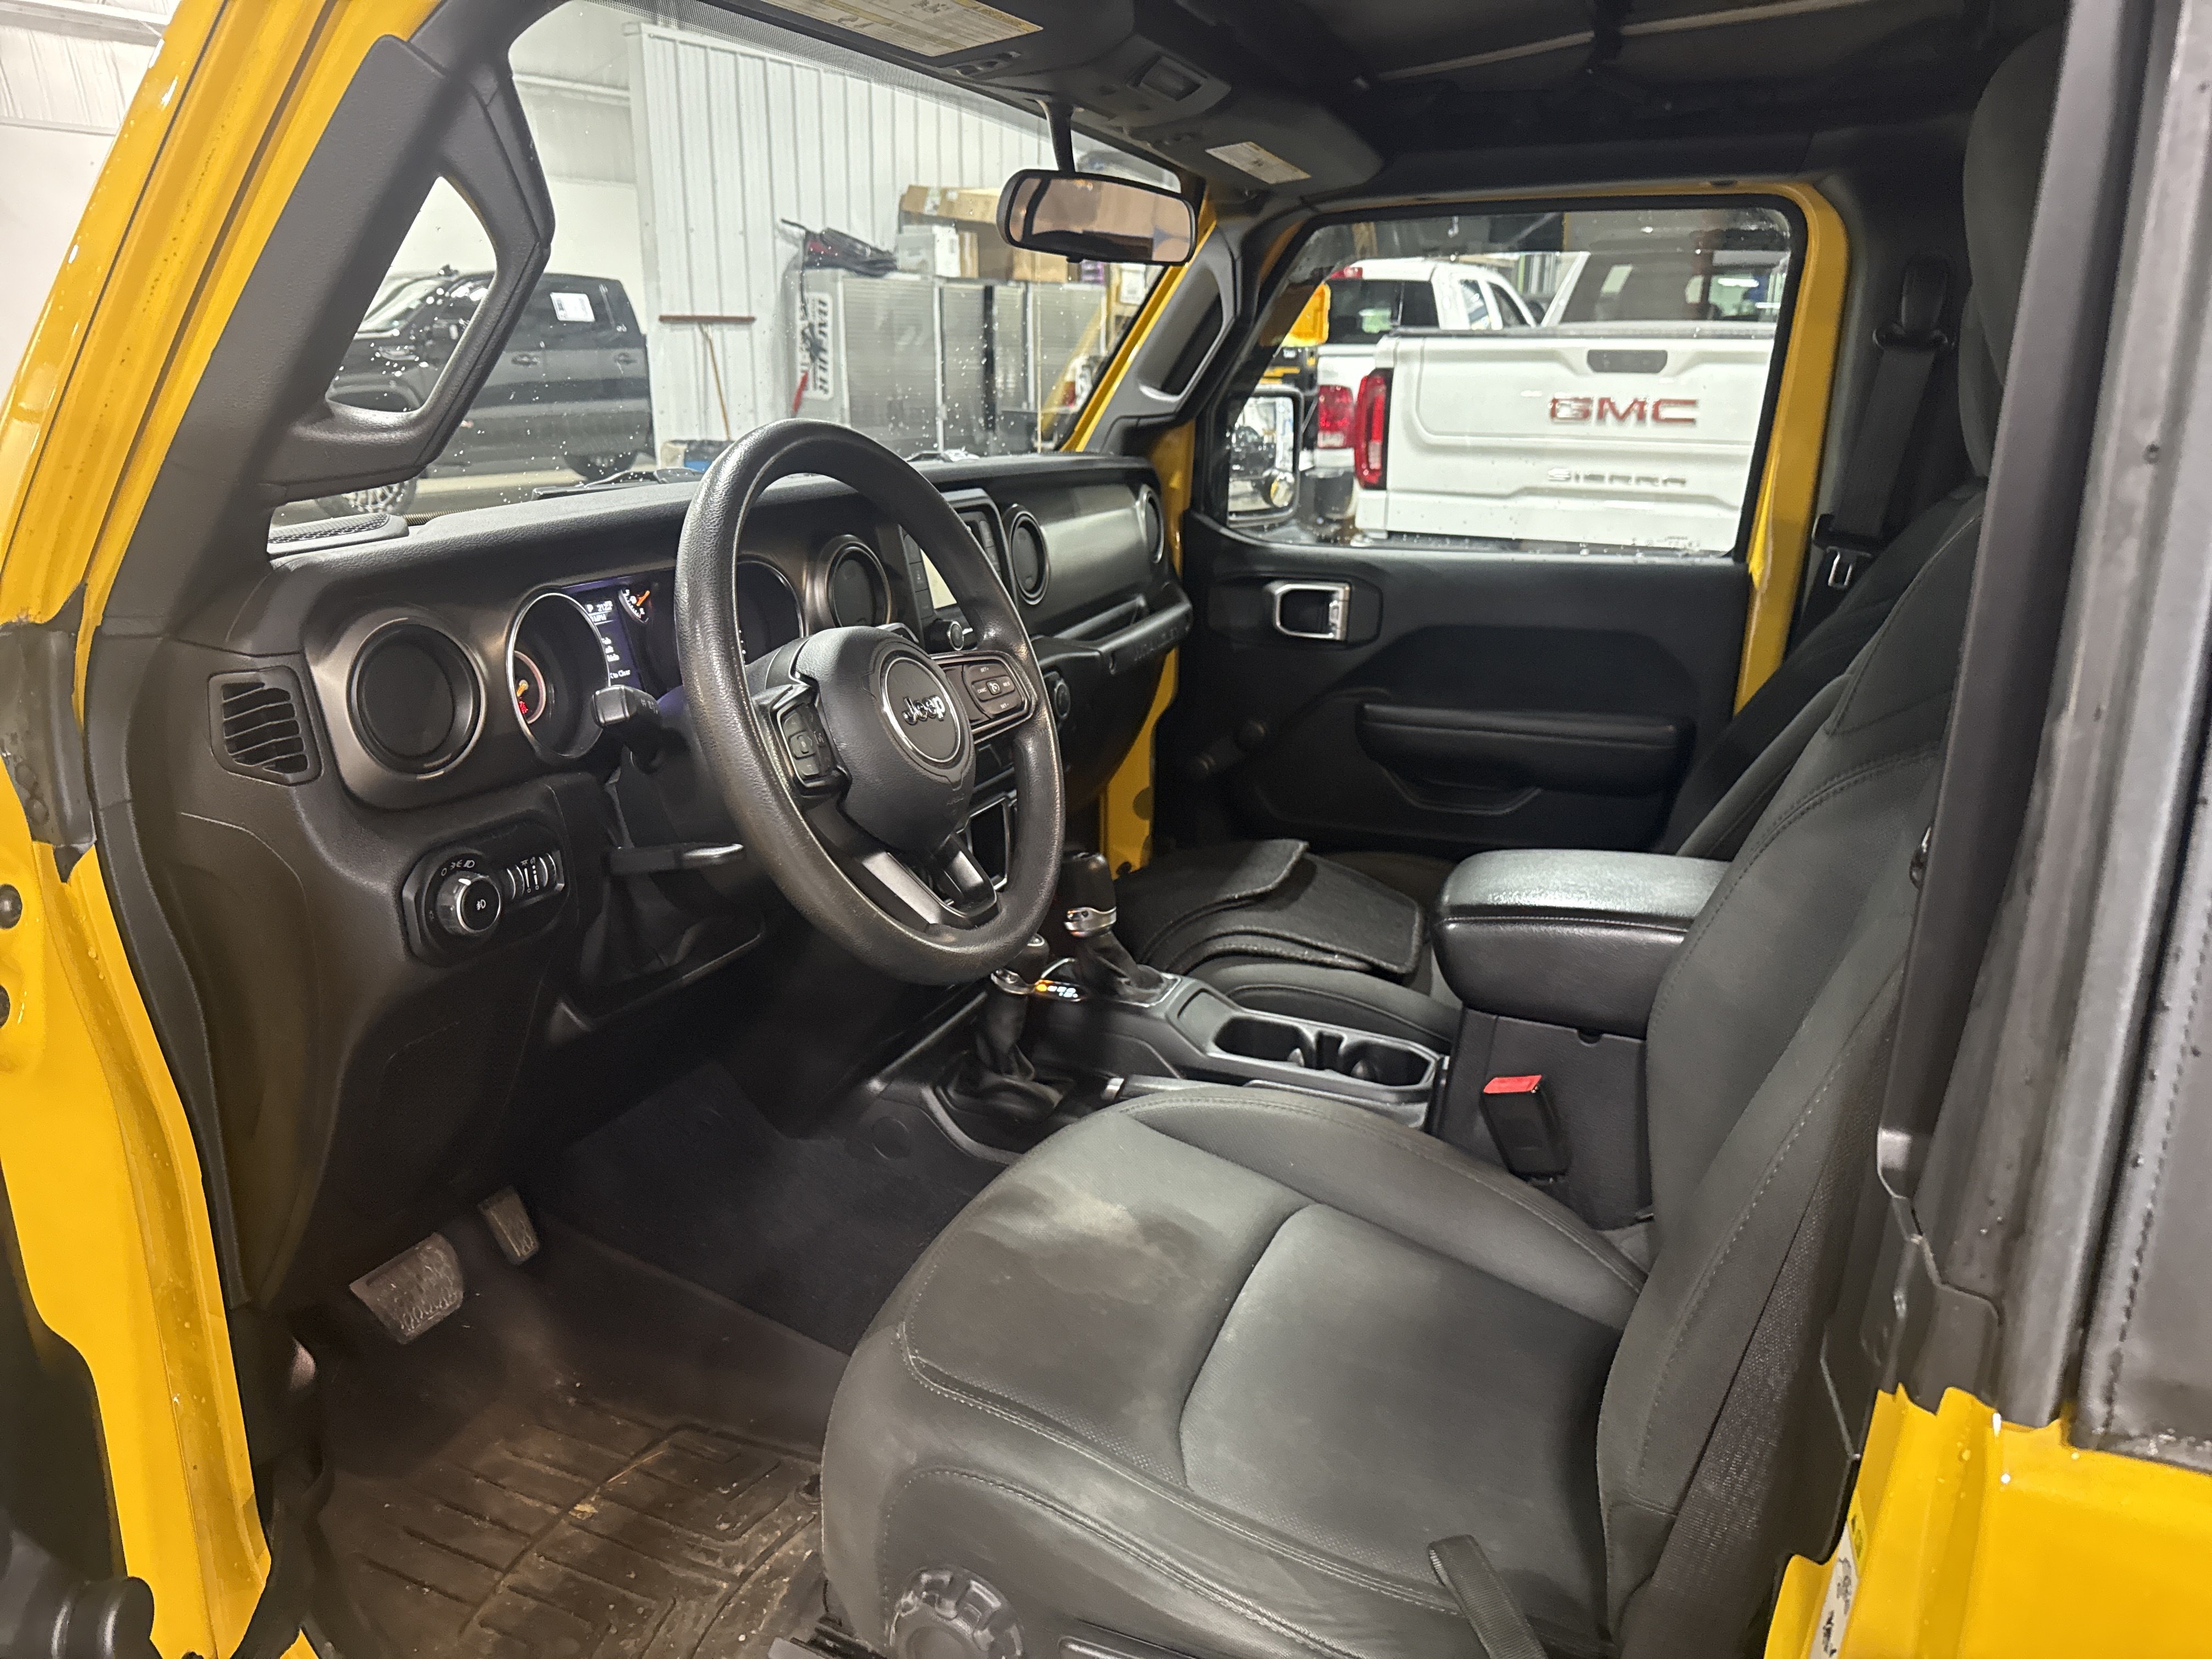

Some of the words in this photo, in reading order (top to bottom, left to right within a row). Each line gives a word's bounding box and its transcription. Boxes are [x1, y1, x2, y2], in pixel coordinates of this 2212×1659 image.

[1549, 396, 1697, 425] GMC
[1548, 468, 1686, 486] SIERRA
[902, 695, 946, 725] Jeep
